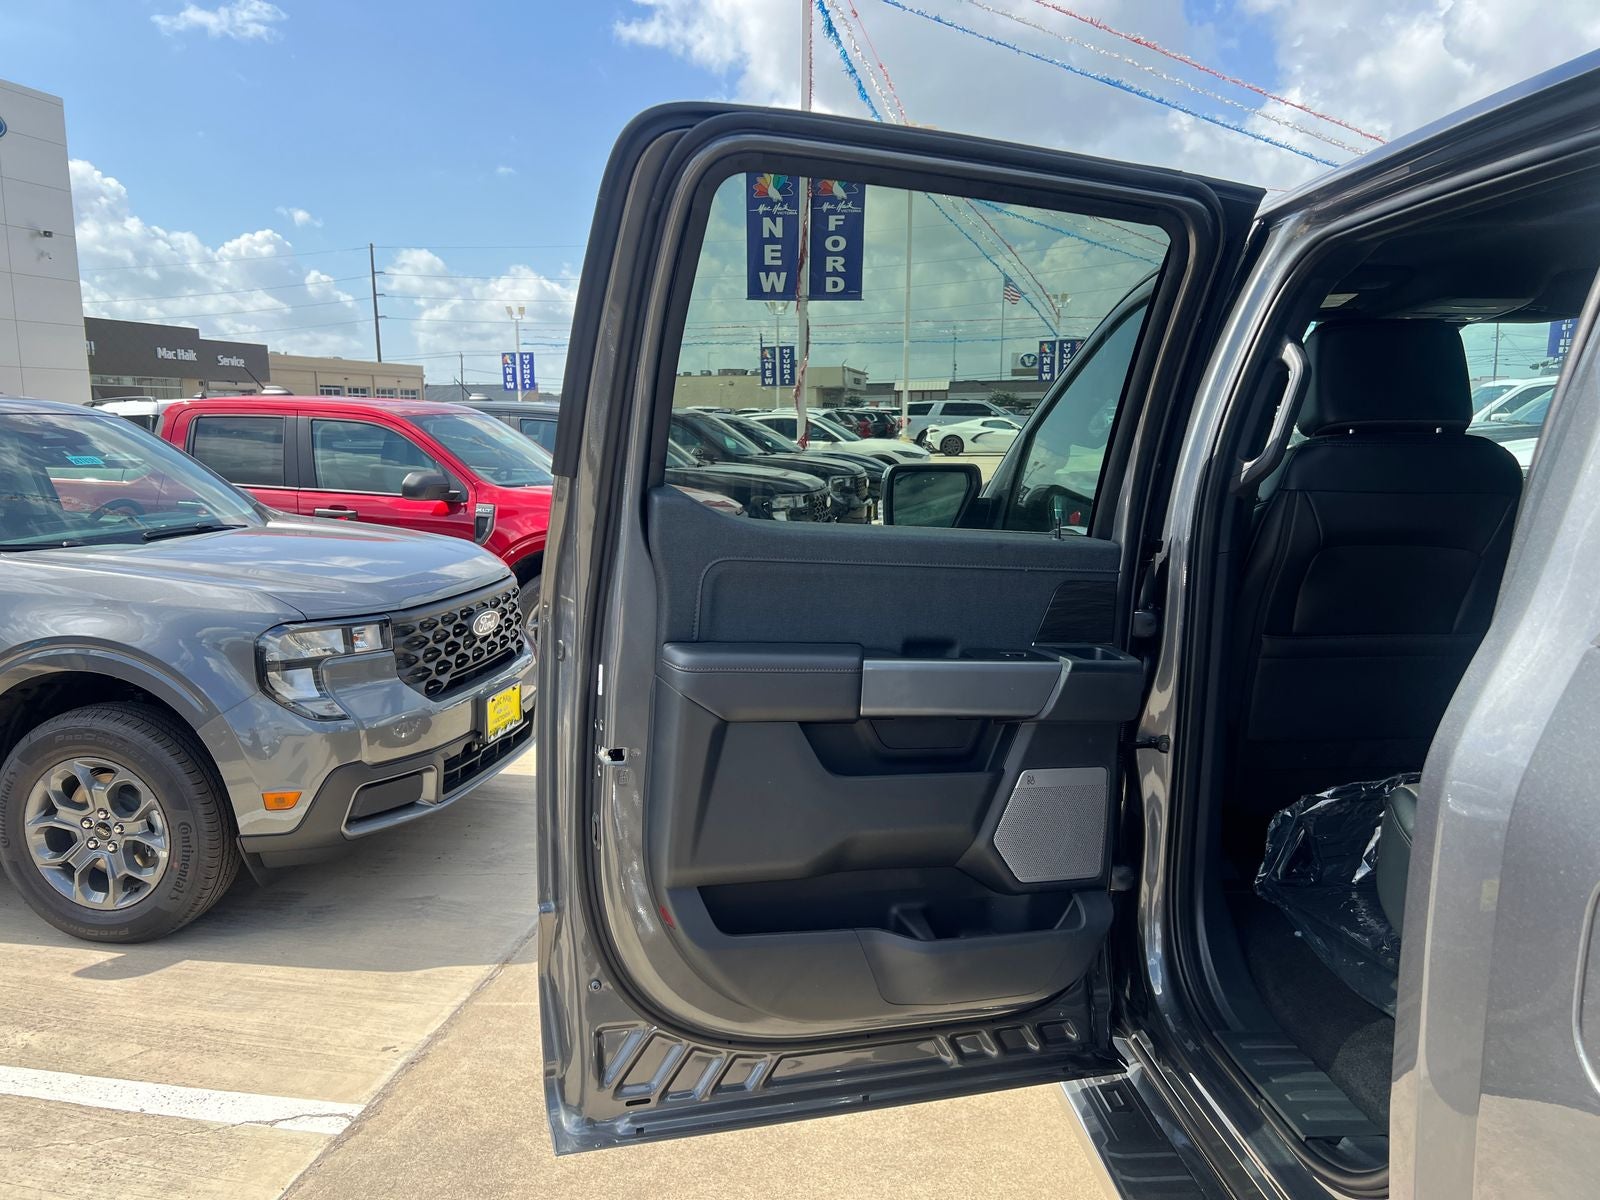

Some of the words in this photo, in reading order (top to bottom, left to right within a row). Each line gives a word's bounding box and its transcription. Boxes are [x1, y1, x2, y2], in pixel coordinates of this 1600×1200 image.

[758, 216, 788, 293] NEW
[824, 214, 847, 293] FORD
[156, 346, 176, 360] Mac
[177, 348, 198, 362] Haik
[217, 354, 246, 368] Service
[783, 348, 791, 384] HYUNDAI
[1063, 342, 1071, 369] HYUN
[505, 367, 515, 389] NEW
[523, 354, 531, 389] HYUNDAI
[764, 362, 774, 385] NEW
[1041, 356, 1052, 381] NEW
[172, 820, 193, 894] Continental
